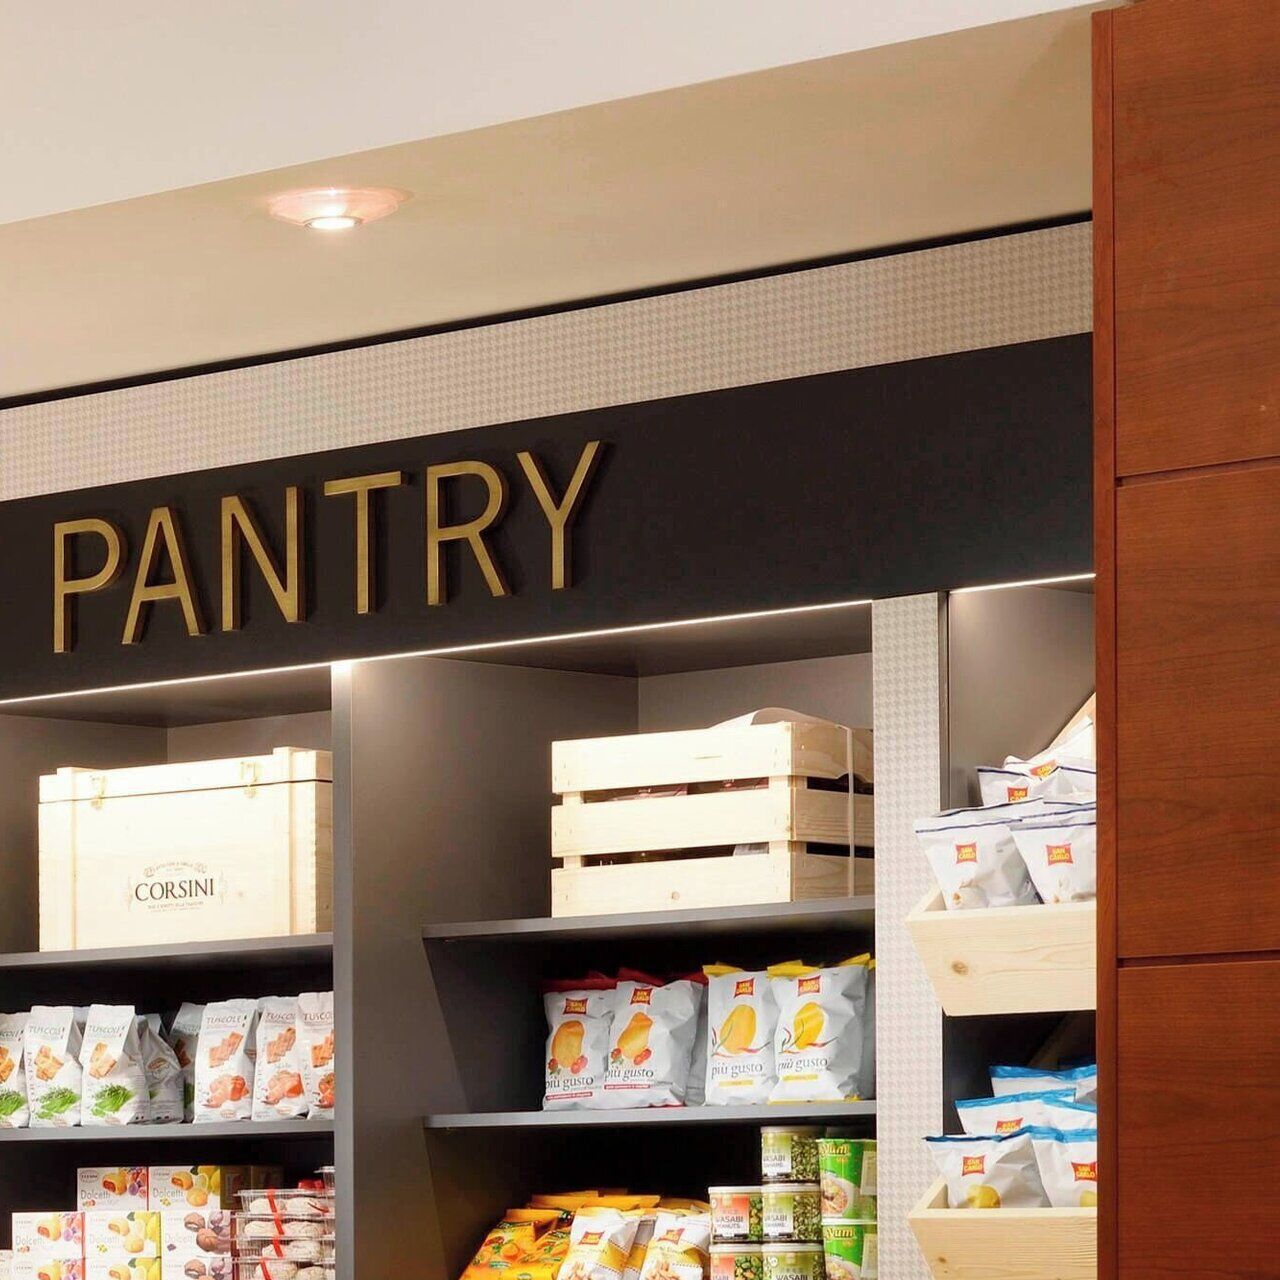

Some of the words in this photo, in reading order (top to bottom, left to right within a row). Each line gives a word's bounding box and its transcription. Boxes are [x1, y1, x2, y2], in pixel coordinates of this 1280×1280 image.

[53, 440, 610, 654] PANTRY
[135, 877, 215, 902] CORSINI
[731, 1063, 763, 1078] gusto
[795, 1058, 828, 1073] gusto
[623, 1067, 654, 1080] gusto
[562, 1076, 594, 1091] gusto
